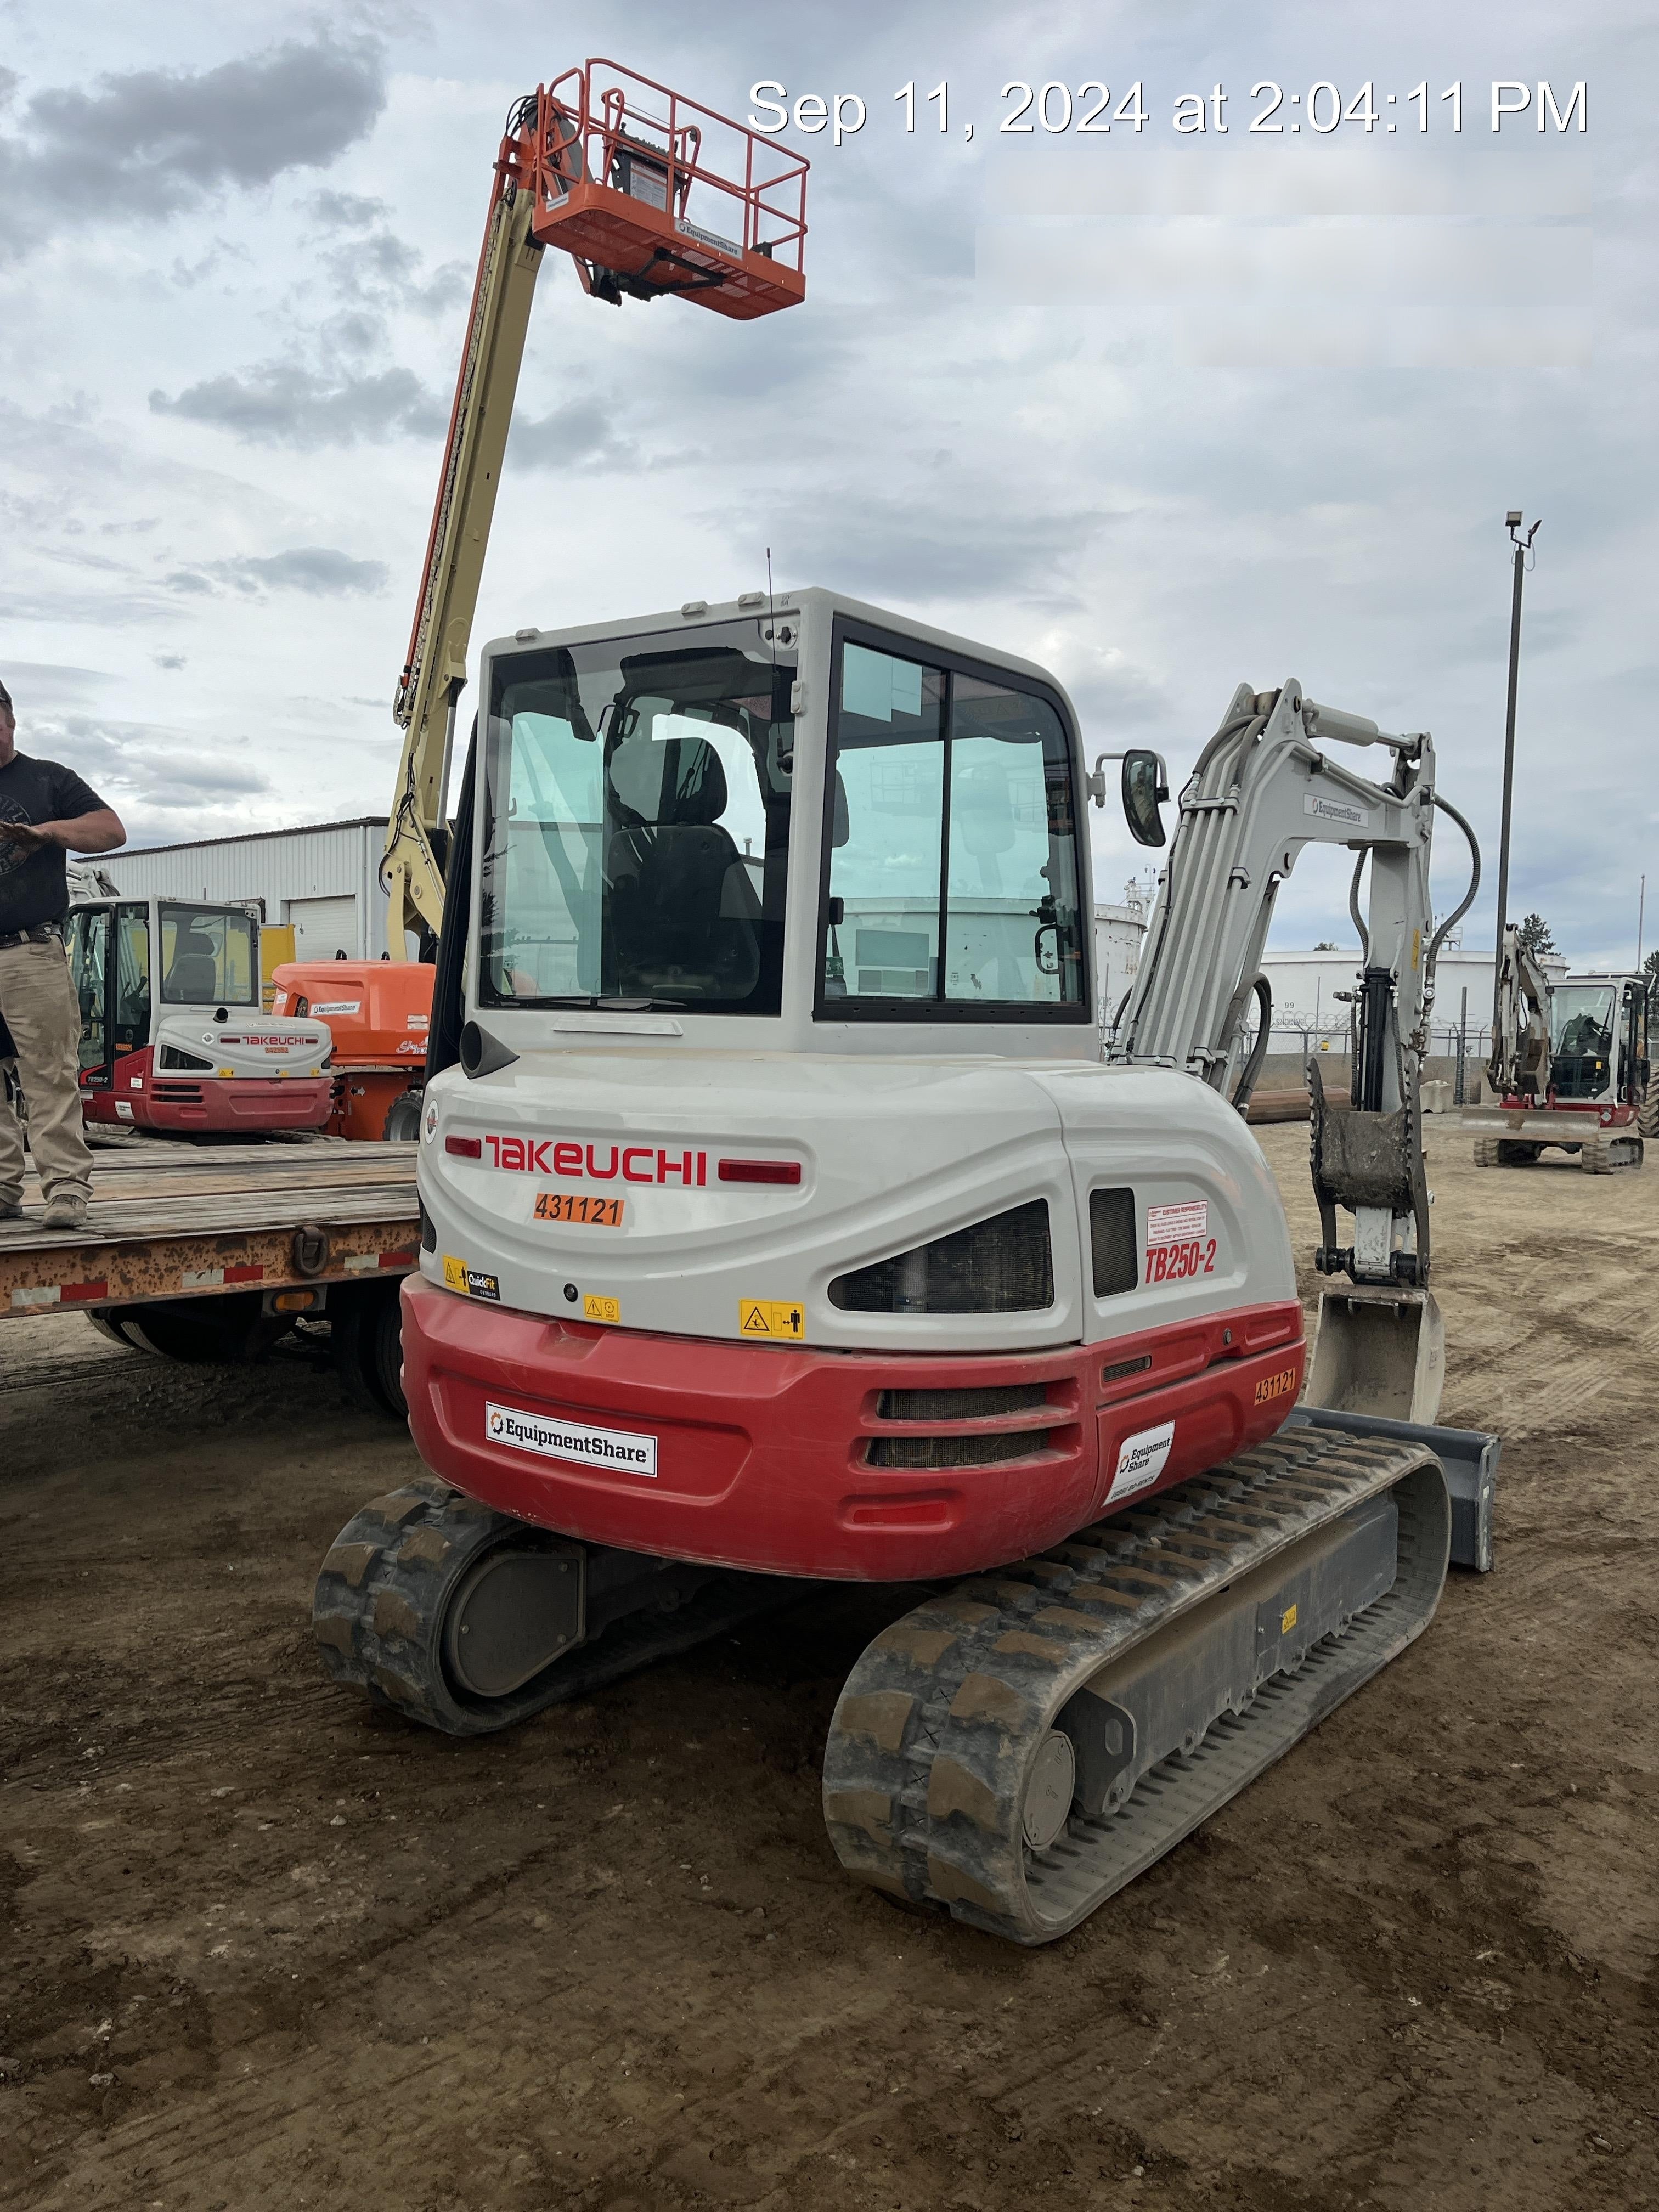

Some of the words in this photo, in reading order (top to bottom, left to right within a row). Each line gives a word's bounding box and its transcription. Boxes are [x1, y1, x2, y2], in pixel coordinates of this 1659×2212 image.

[686, 226, 738, 255] EquipmentShare
[1319, 801, 1361, 822] EquipmentShare
[242, 1036, 304, 1045] TAKEUCHI
[486, 1135, 706, 1186] TAKEUCHI
[535, 1195, 619, 1224] 431121
[1146, 1239, 1216, 1284] TB250-2
[469, 1274, 495, 1290] QuickFit
[1256, 1369, 1293, 1402] 431121
[506, 1418, 646, 1458] EquipmentShare
[1131, 1437, 1170, 1460] Equipment
[1128, 1458, 1150, 1472] Share
